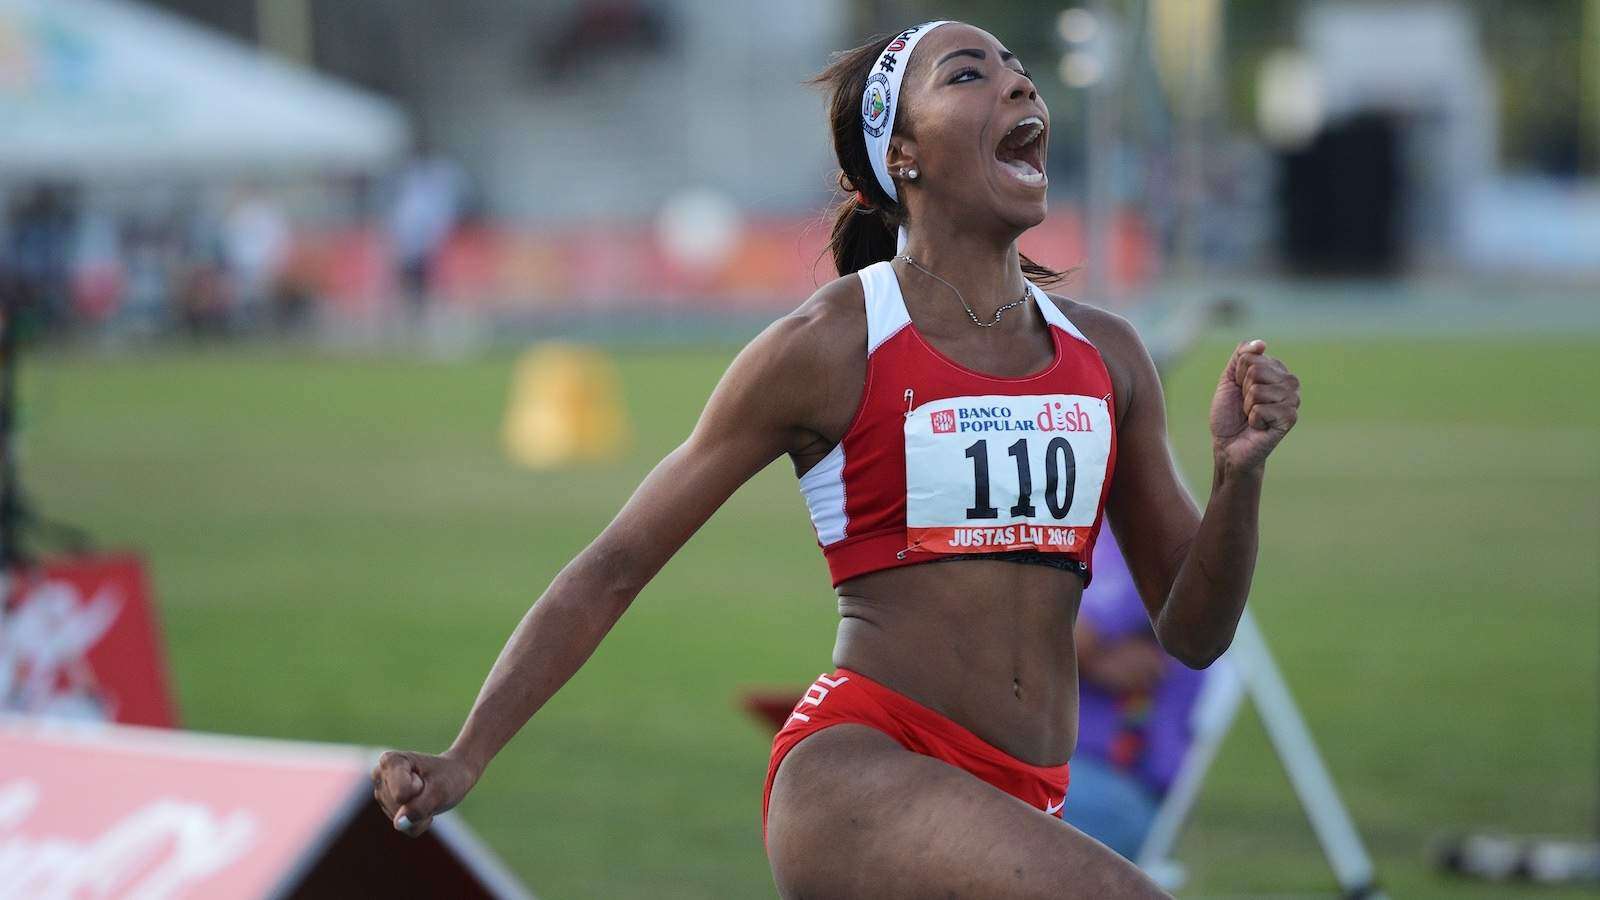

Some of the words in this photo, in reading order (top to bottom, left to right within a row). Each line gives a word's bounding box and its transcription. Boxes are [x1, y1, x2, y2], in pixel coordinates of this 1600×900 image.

[959, 407, 1012, 419] BANCO
[1037, 402, 1092, 432] dish
[965, 436, 1076, 520] 110
[949, 527, 1015, 547] JUSTAS
[1048, 528, 1076, 546] 2016
